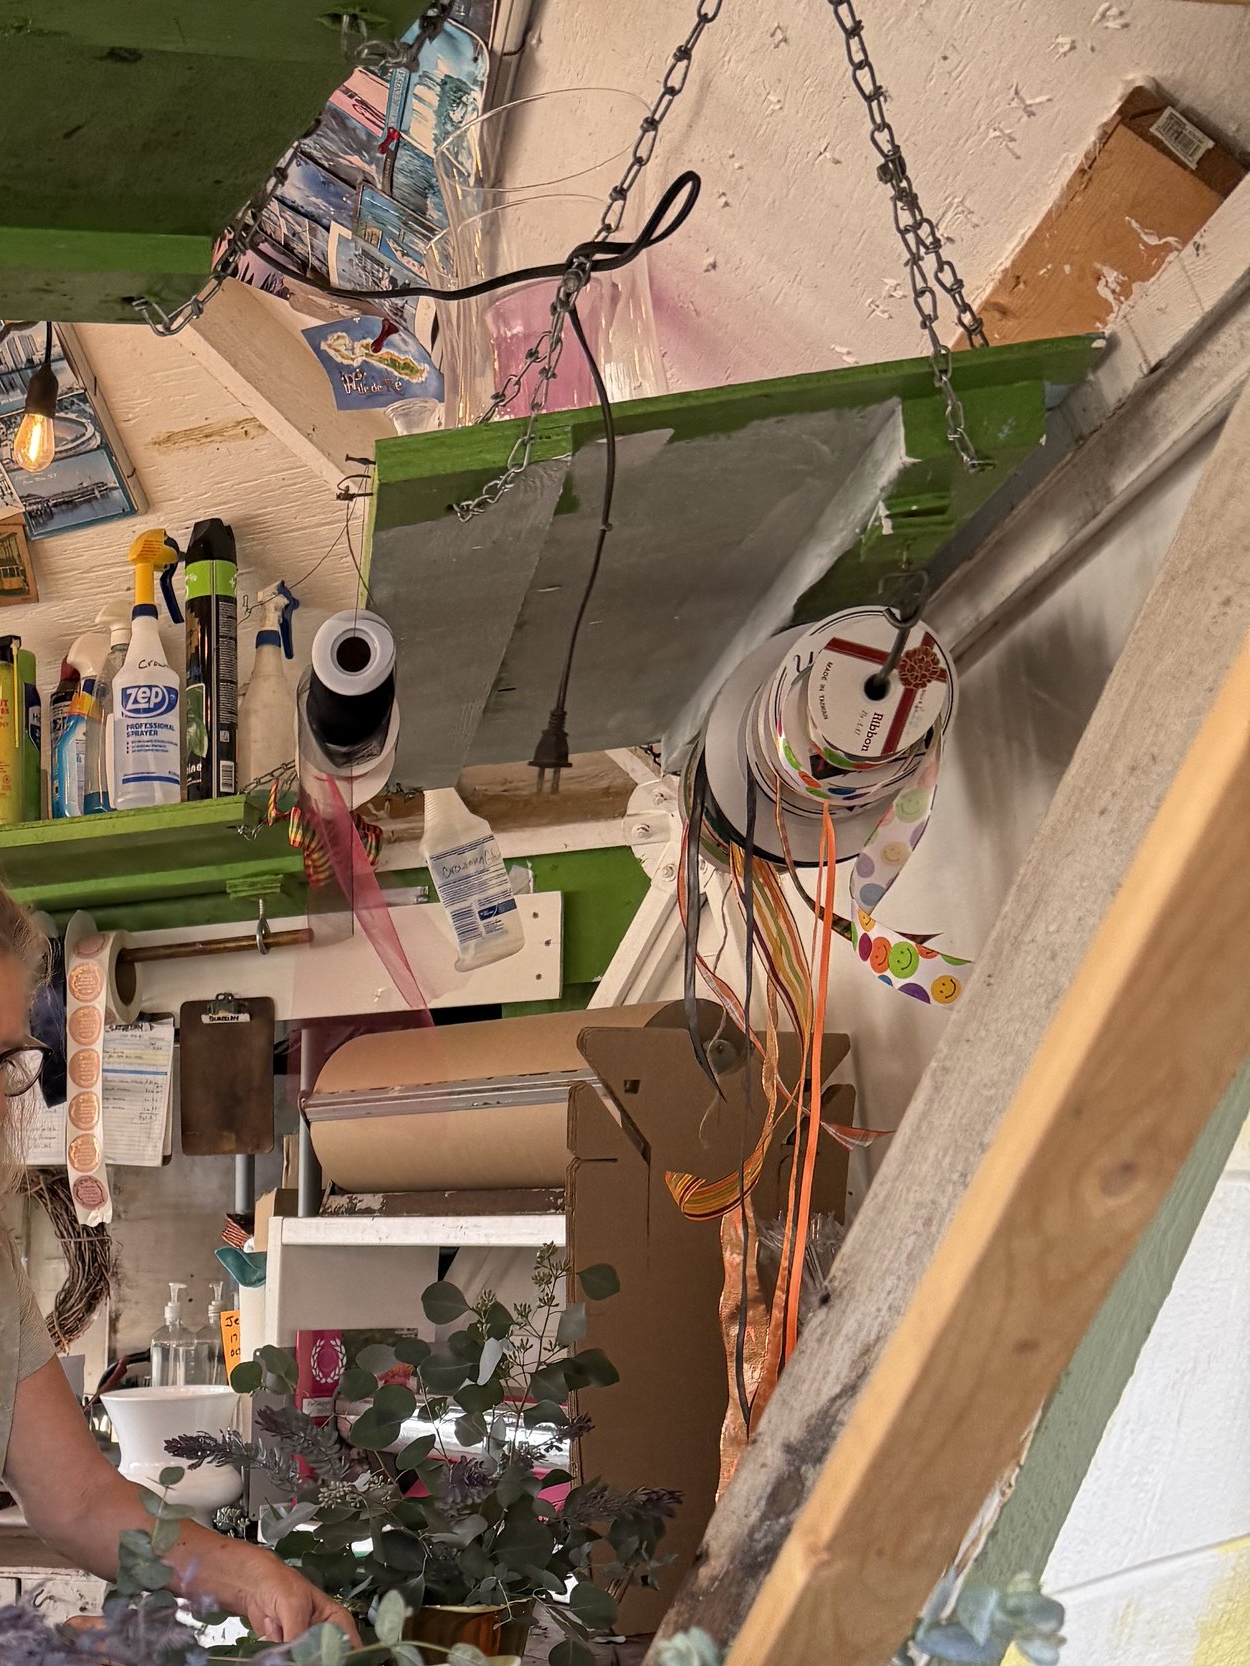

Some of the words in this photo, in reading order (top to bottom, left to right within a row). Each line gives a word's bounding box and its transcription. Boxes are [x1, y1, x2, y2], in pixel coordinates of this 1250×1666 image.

[820, 661, 834, 681] MADE
[126, 722, 175, 731] PROFESSIONAL
[126, 729, 158, 738] SPRAYER
